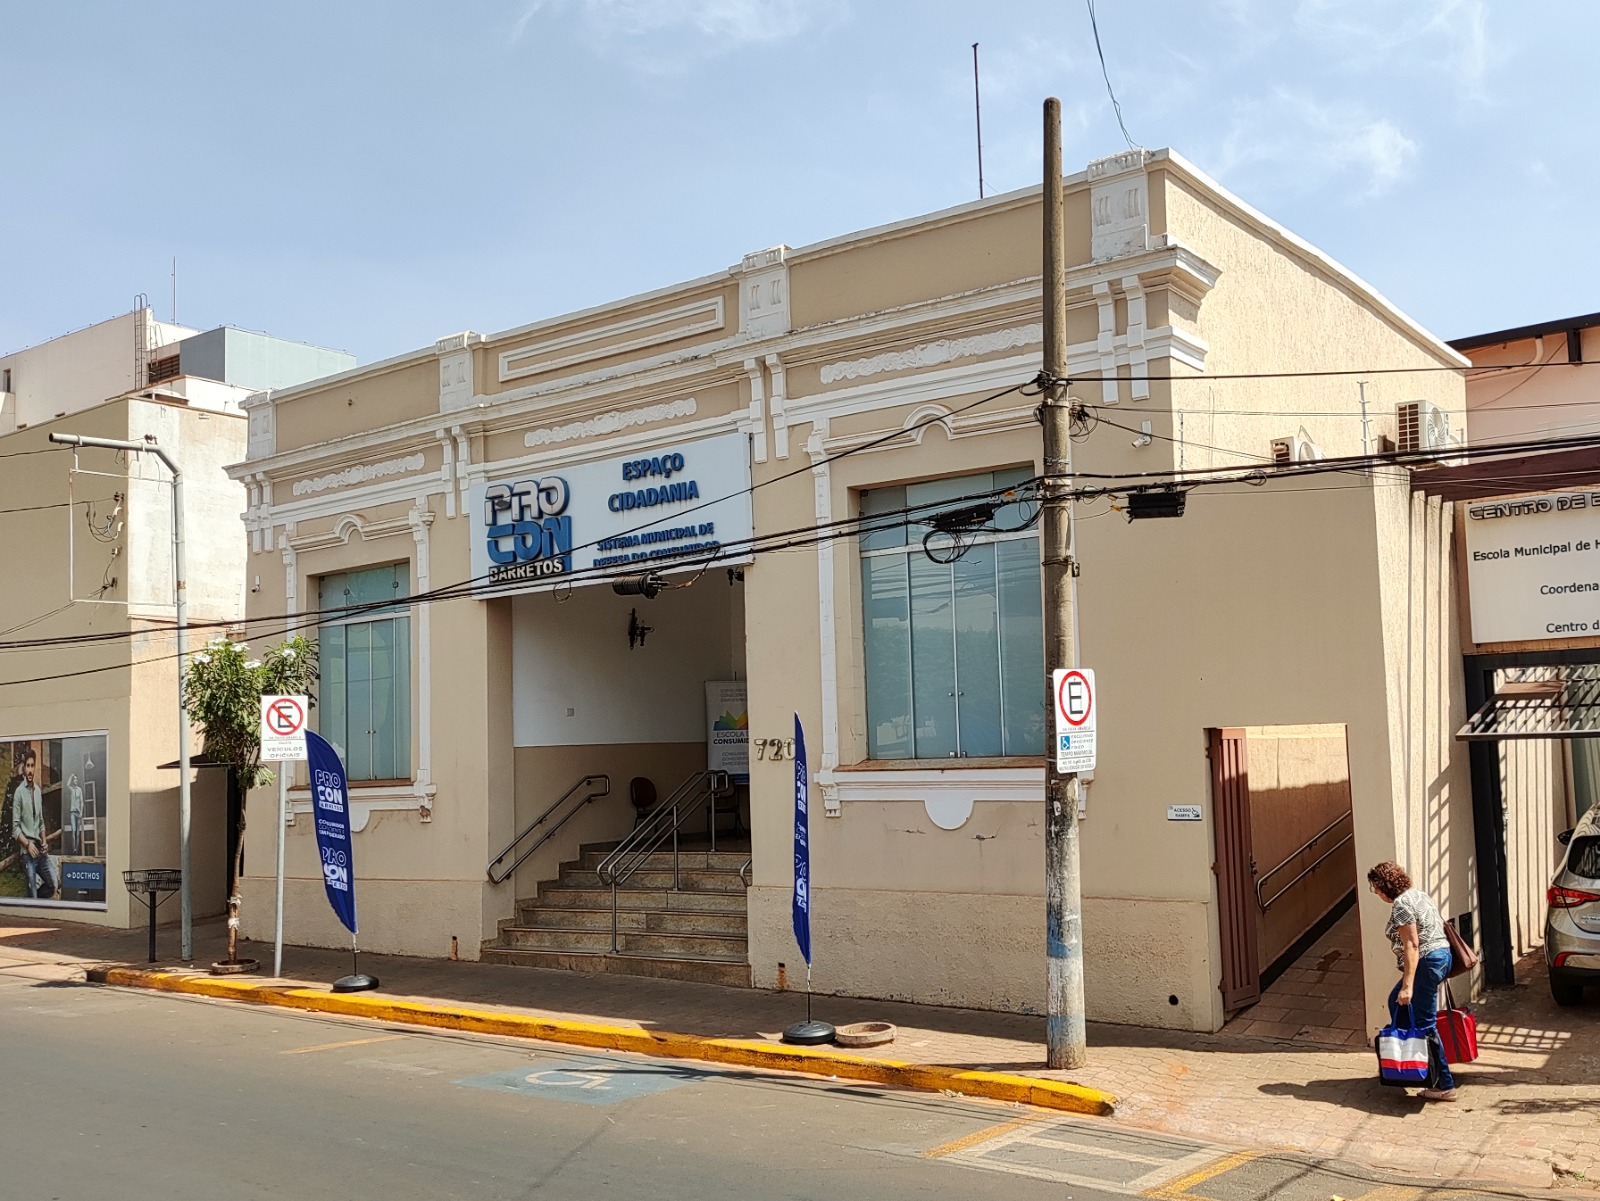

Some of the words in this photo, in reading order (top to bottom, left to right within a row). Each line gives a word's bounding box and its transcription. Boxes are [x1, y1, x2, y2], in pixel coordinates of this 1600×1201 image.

[622, 453, 684, 481] ESPAÇO
[484, 476, 570, 526] PRO
[608, 480, 699, 512] CIDADANIA
[1470, 499, 1552, 520] CENTRO
[1557, 495, 1585, 511] DE
[487, 515, 572, 572] CON
[596, 534, 640, 551] SISTEMA
[640, 525, 697, 546] MUNICIPAL
[699, 522, 714, 536] DE
[1473, 548, 1510, 561] Escola
[1515, 542, 1571, 557] Municipal
[1575, 540, 1591, 551] de
[490, 559, 563, 582] BARRETOS
[1540, 582, 1599, 595] Coordena
[1546, 621, 1588, 633] Centro
[753, 738, 796, 761] 720
[315, 769, 341, 788] PRO
[317, 786, 343, 805] CON
